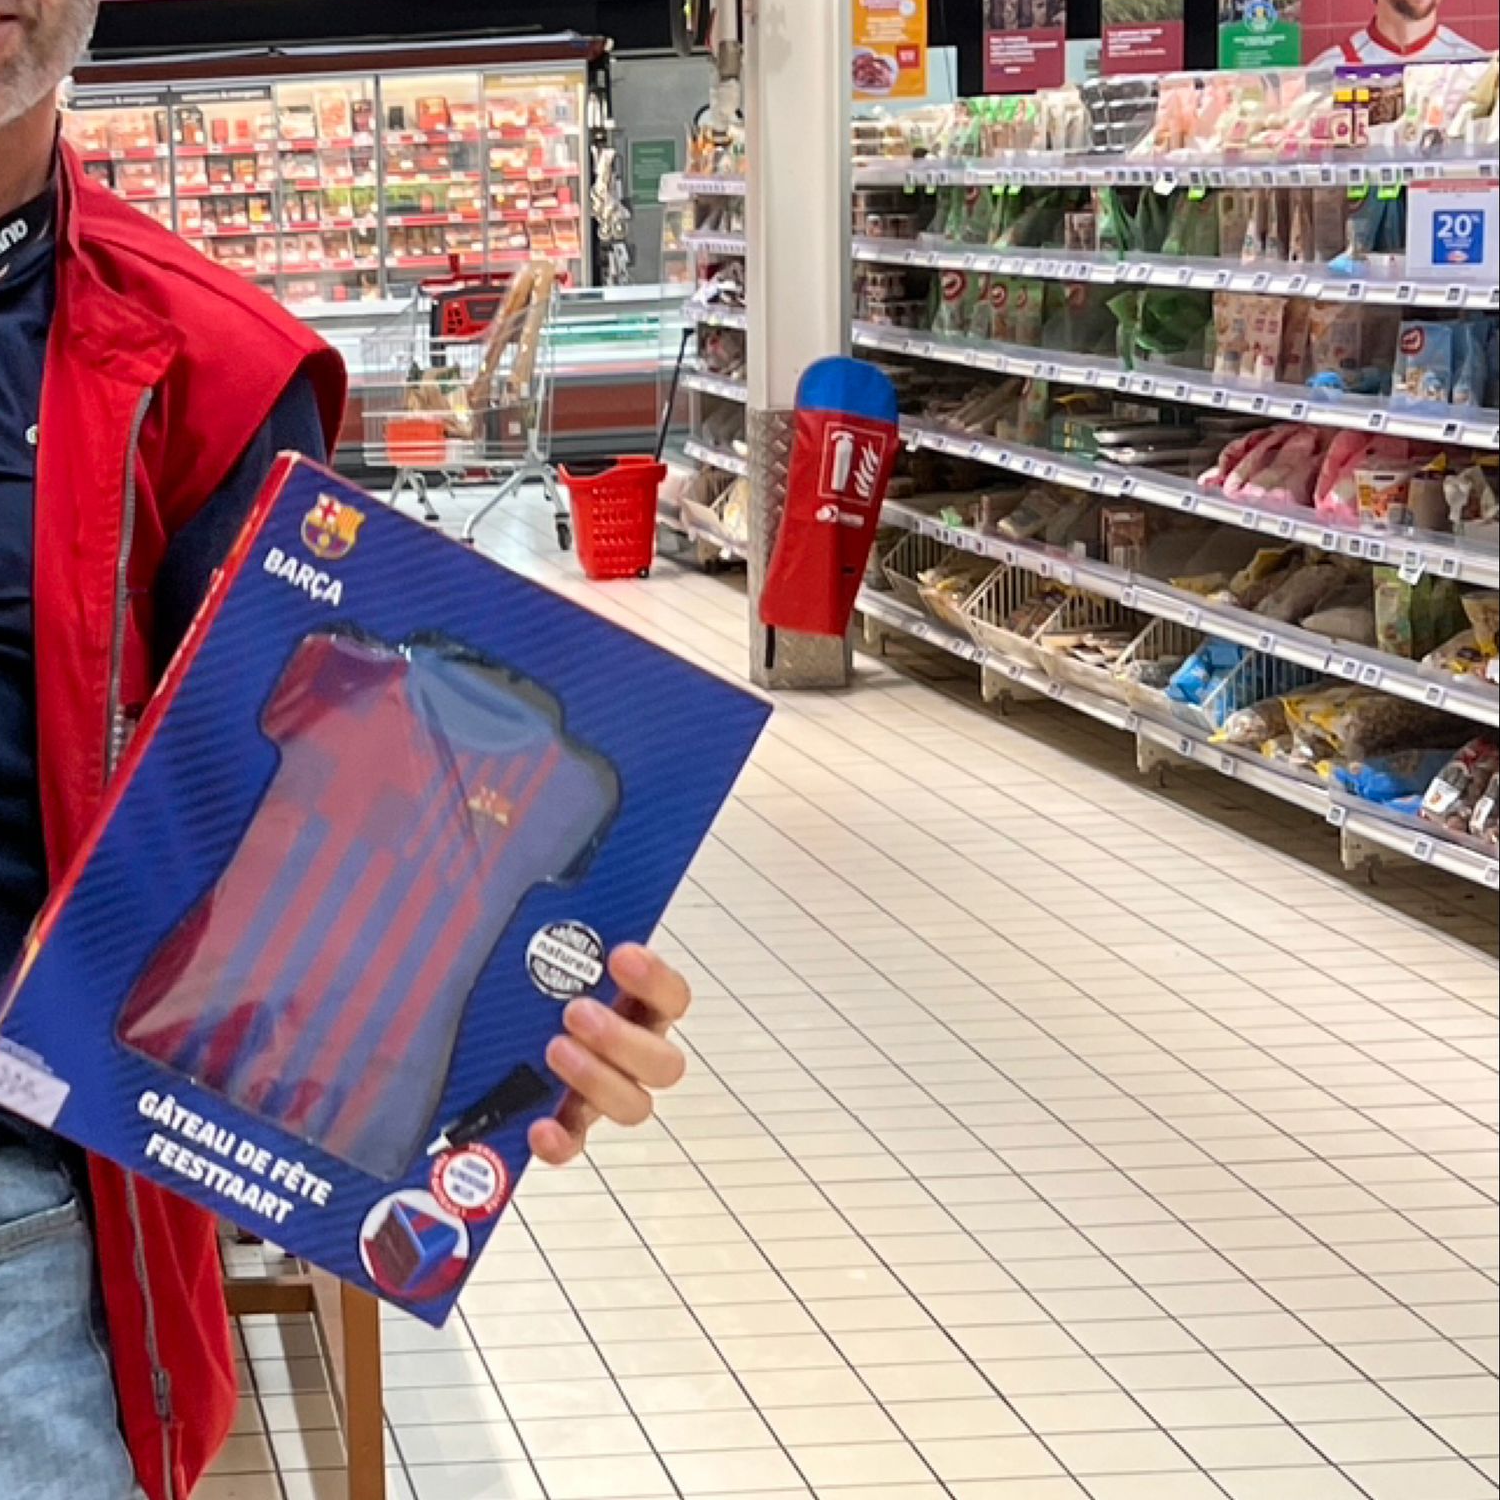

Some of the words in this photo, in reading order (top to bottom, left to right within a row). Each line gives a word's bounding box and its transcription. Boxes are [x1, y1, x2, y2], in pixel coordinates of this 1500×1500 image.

[263, 547, 343, 607] BARÇA
[536, 939, 596, 977] naturels
[138, 1089, 236, 1158] GÂTEAU
[234, 1138, 273, 1175] DE
[269, 1156, 333, 1207] FÊTE
[144, 1131, 295, 1224] FEESTTAART
